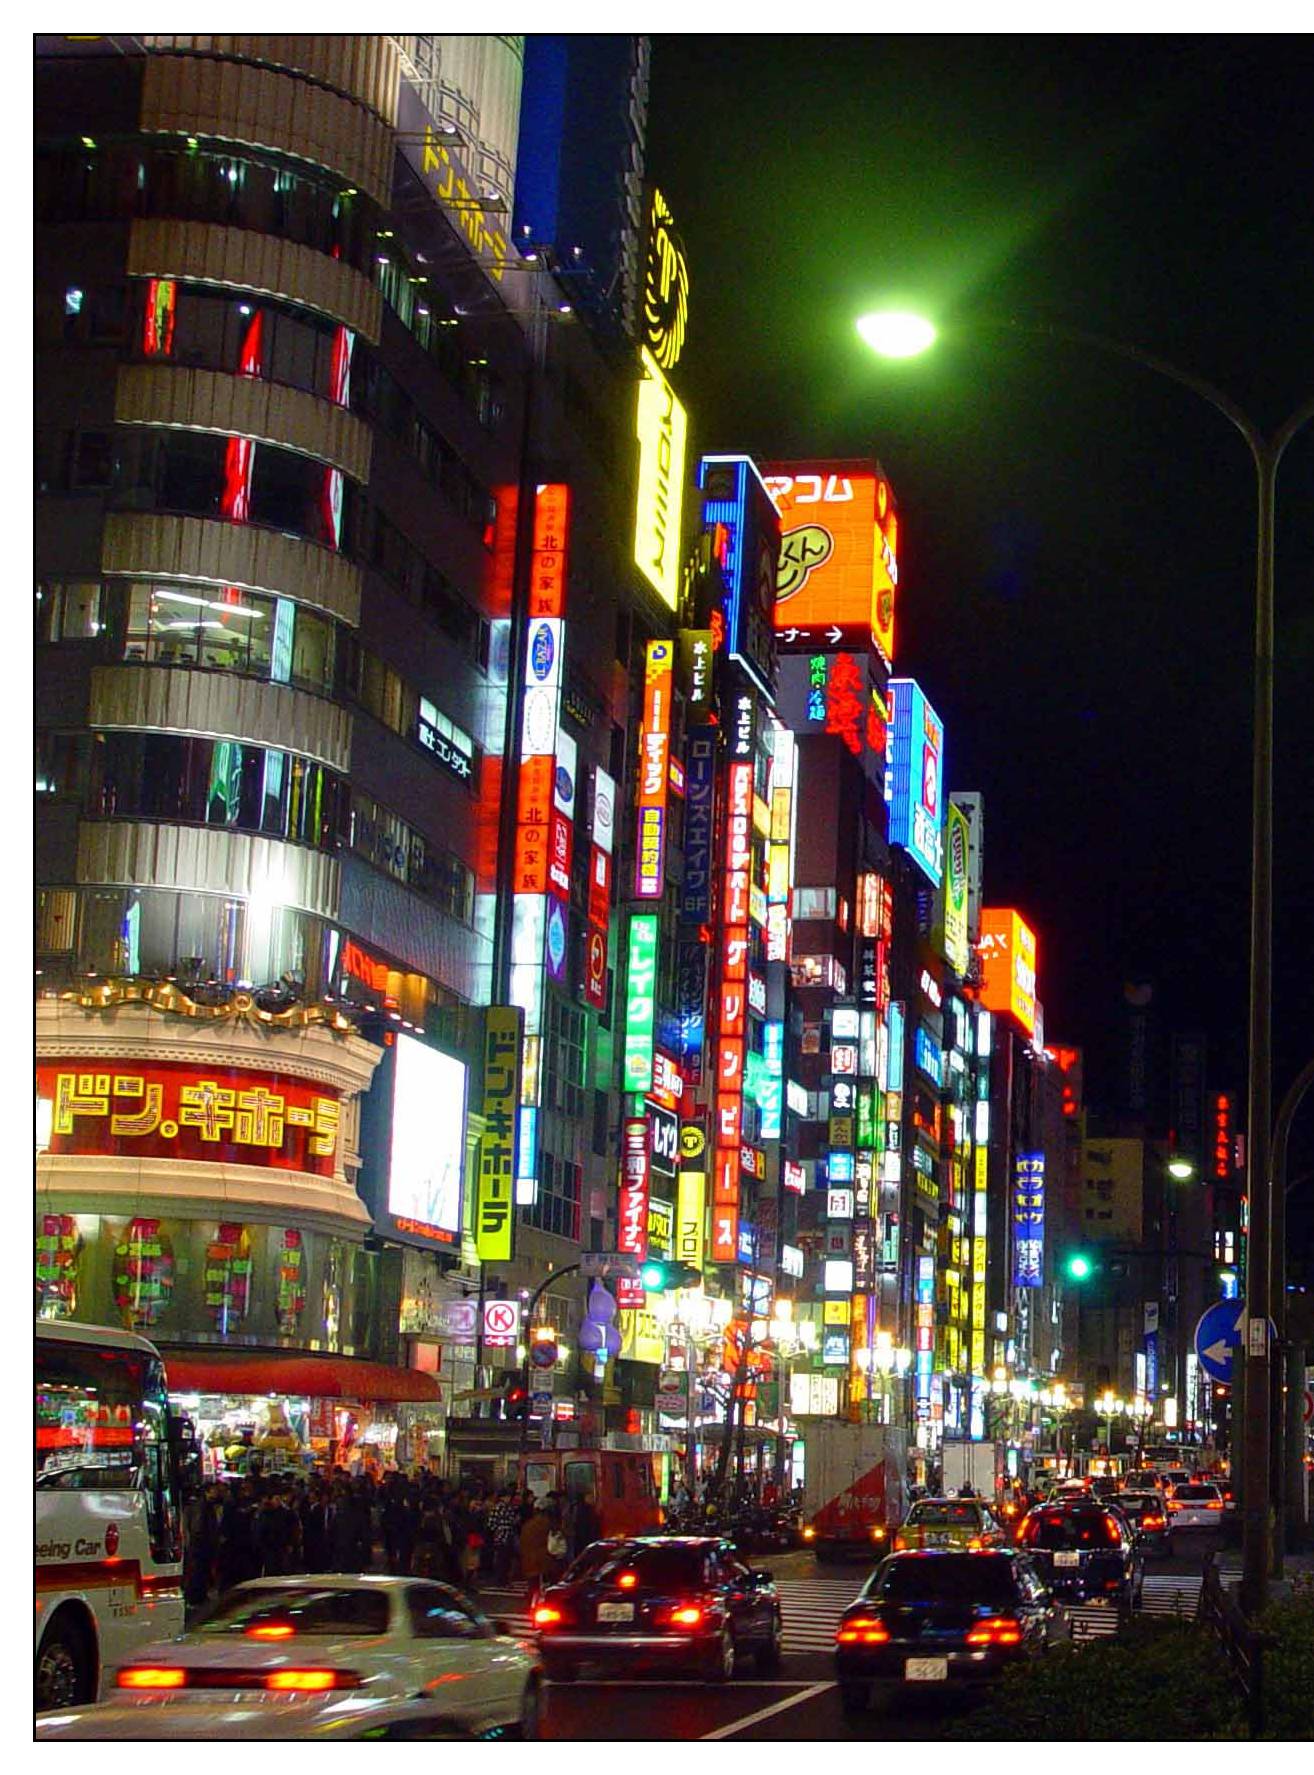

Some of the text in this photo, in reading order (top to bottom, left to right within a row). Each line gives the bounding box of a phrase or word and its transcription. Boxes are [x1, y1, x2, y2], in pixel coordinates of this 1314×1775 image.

[533, 534, 560, 614] 北の家族
[522, 807, 546, 890] 北の家族
[629, 945, 655, 1022] レイク
[75, 1539, 101, 1557] Car
